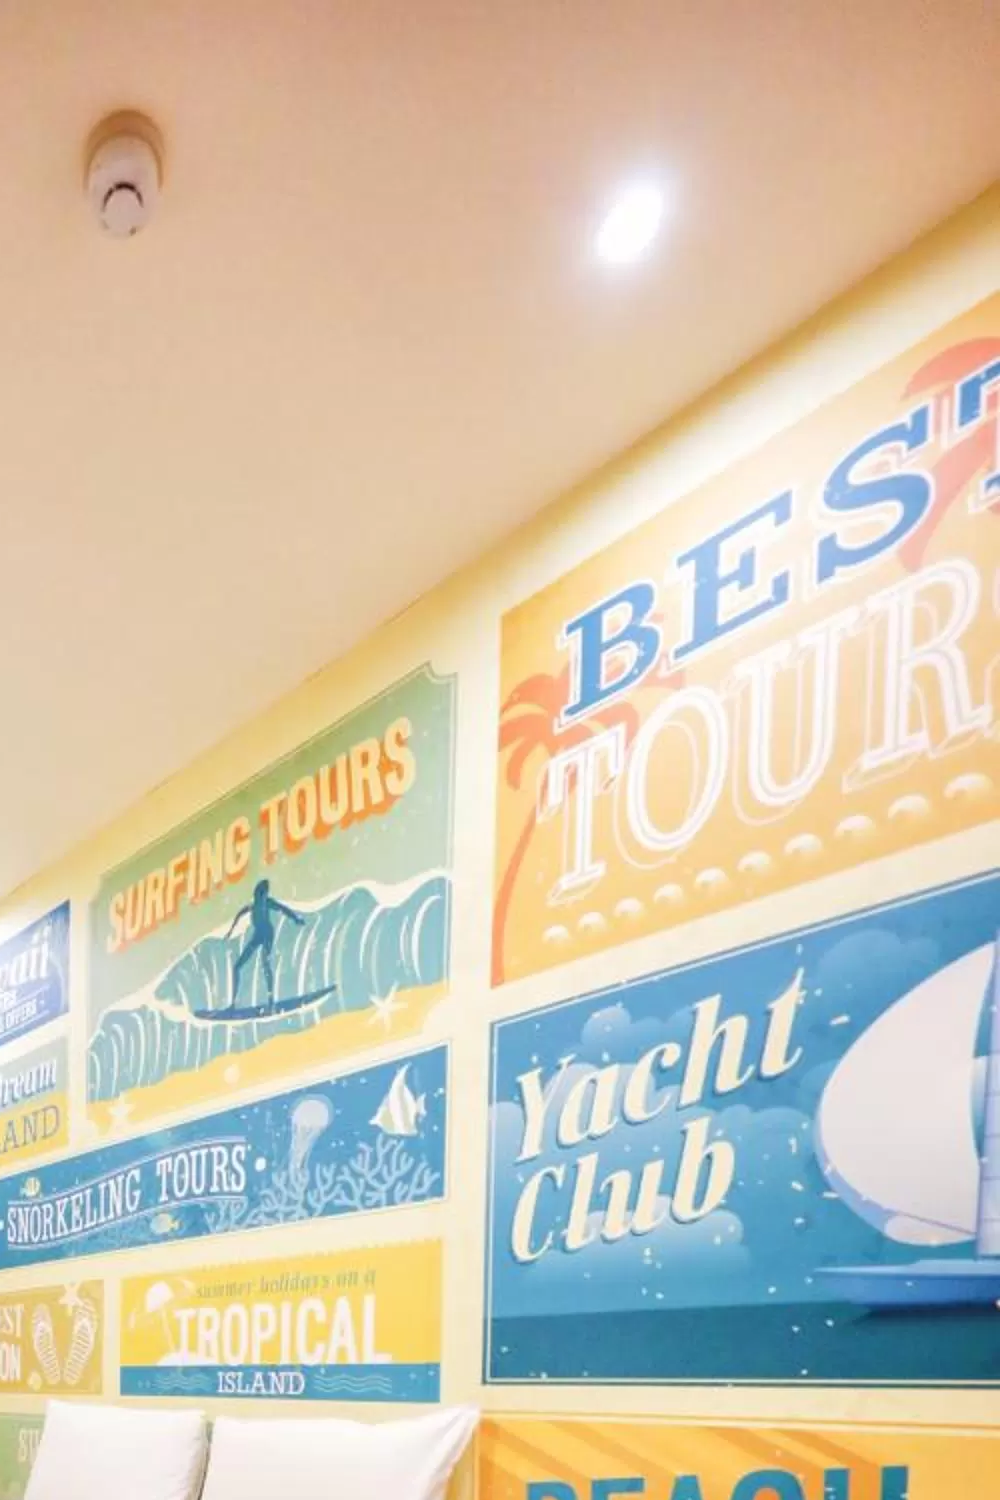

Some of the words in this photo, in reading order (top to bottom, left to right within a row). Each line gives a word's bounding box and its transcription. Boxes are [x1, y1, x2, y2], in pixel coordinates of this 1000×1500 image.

[540, 555, 1000, 896] TOUR
[107, 815, 252, 953] SURFING
[258, 716, 417, 864] TOURS
[515, 967, 805, 1164] Yacht
[7, 1168, 142, 1244] SNORKELING
[155, 1143, 247, 1202] TOURS
[511, 1117, 735, 1263] Club
[174, 1293, 393, 1365] TROPICAL
[217, 1370, 306, 1396] ISLAND
